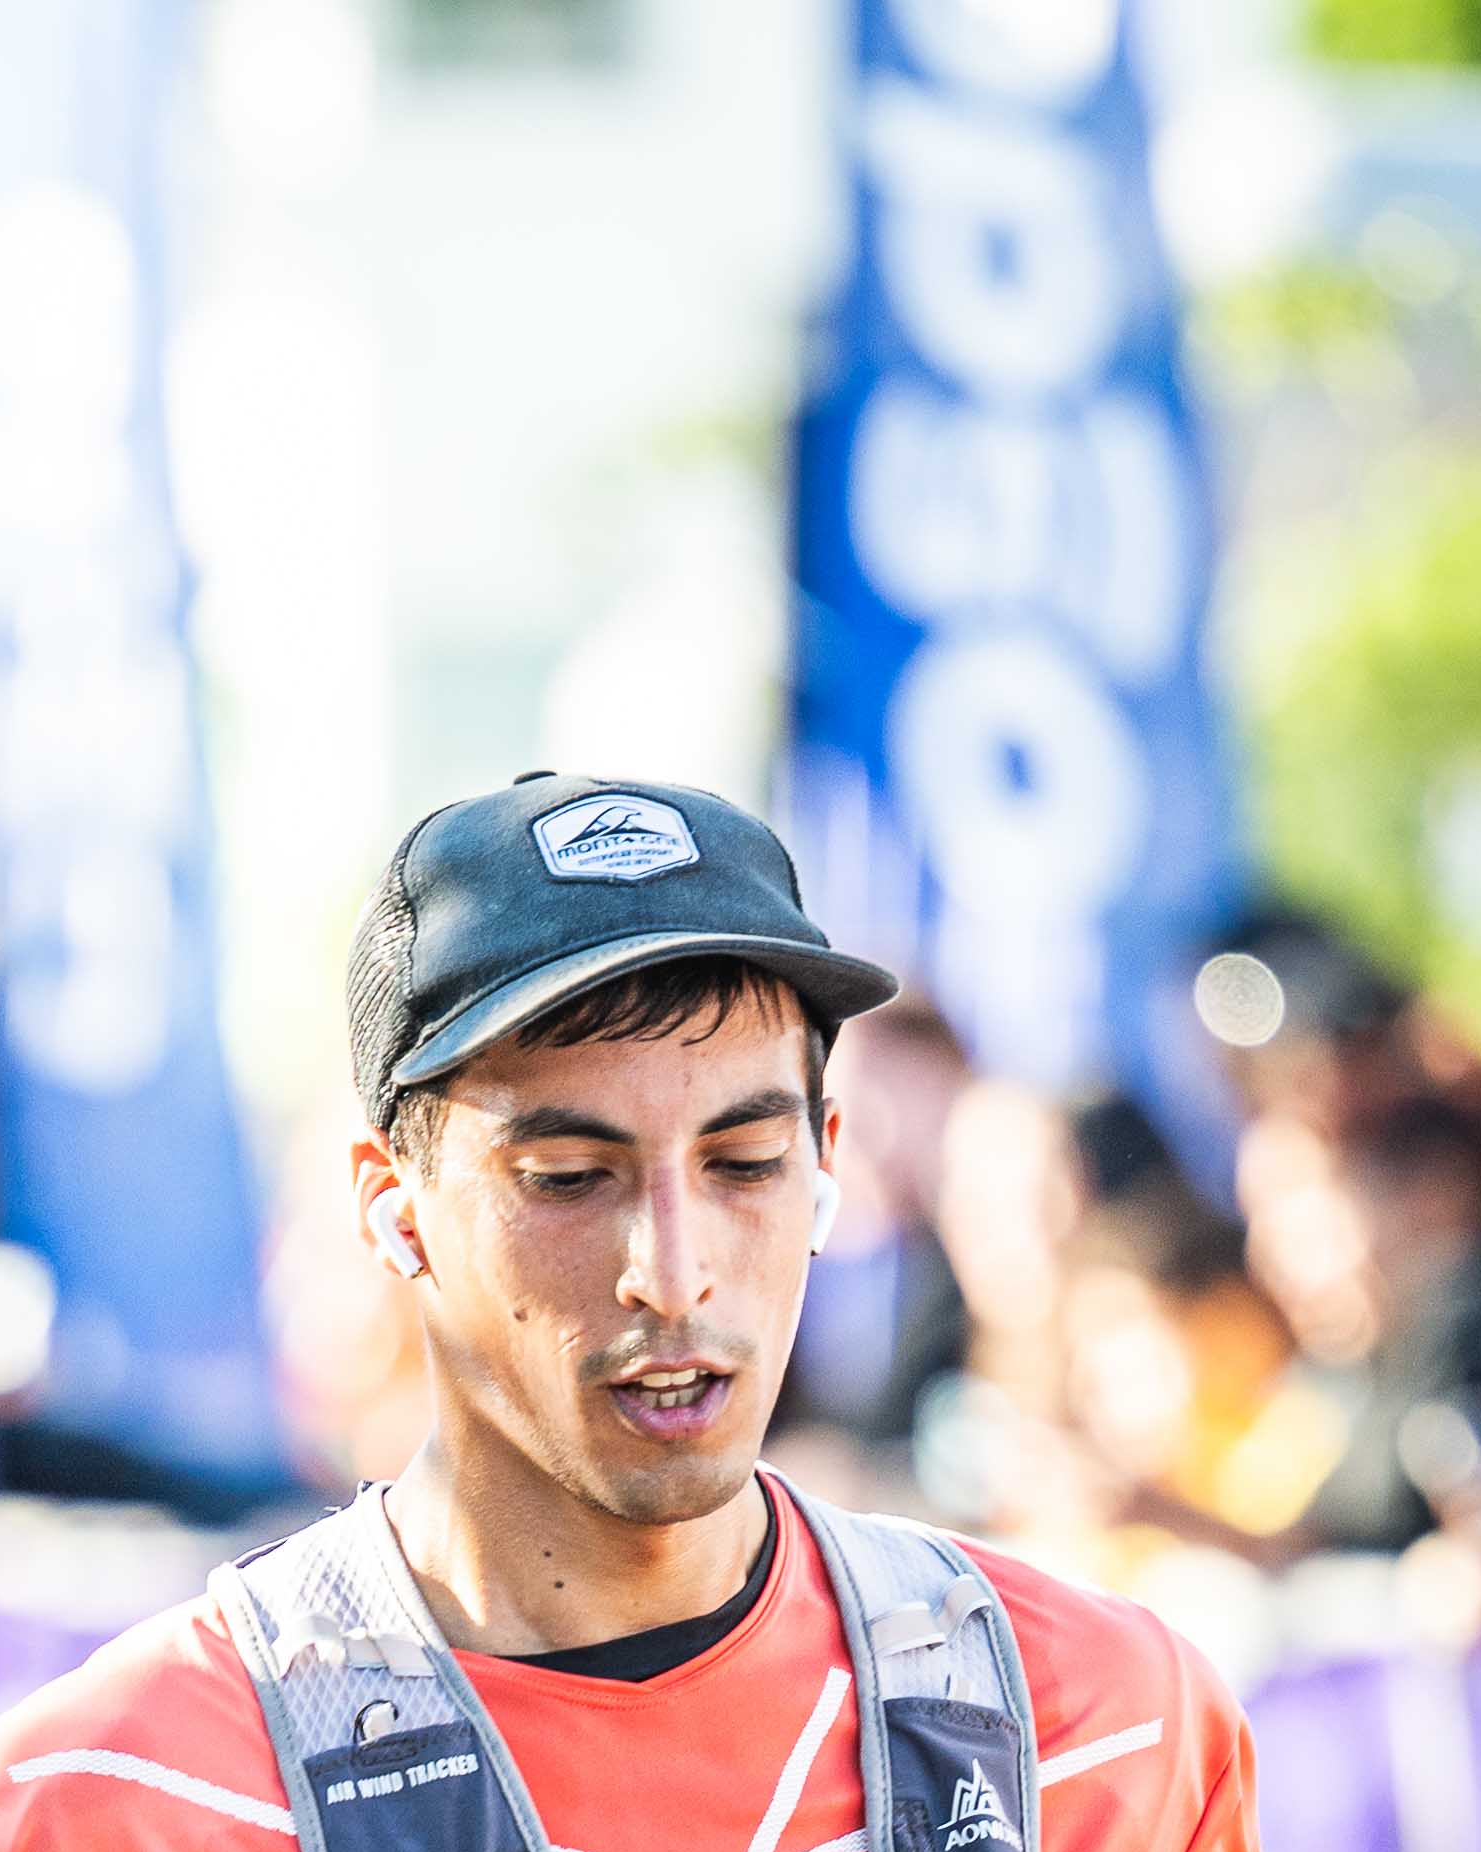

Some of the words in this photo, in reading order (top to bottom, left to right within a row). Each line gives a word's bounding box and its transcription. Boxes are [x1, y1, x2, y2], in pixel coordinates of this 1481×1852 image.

[327, 1780, 356, 1806] AIR
[357, 1771, 405, 1799] WIND
[406, 1753, 479, 1788] TRACKER
